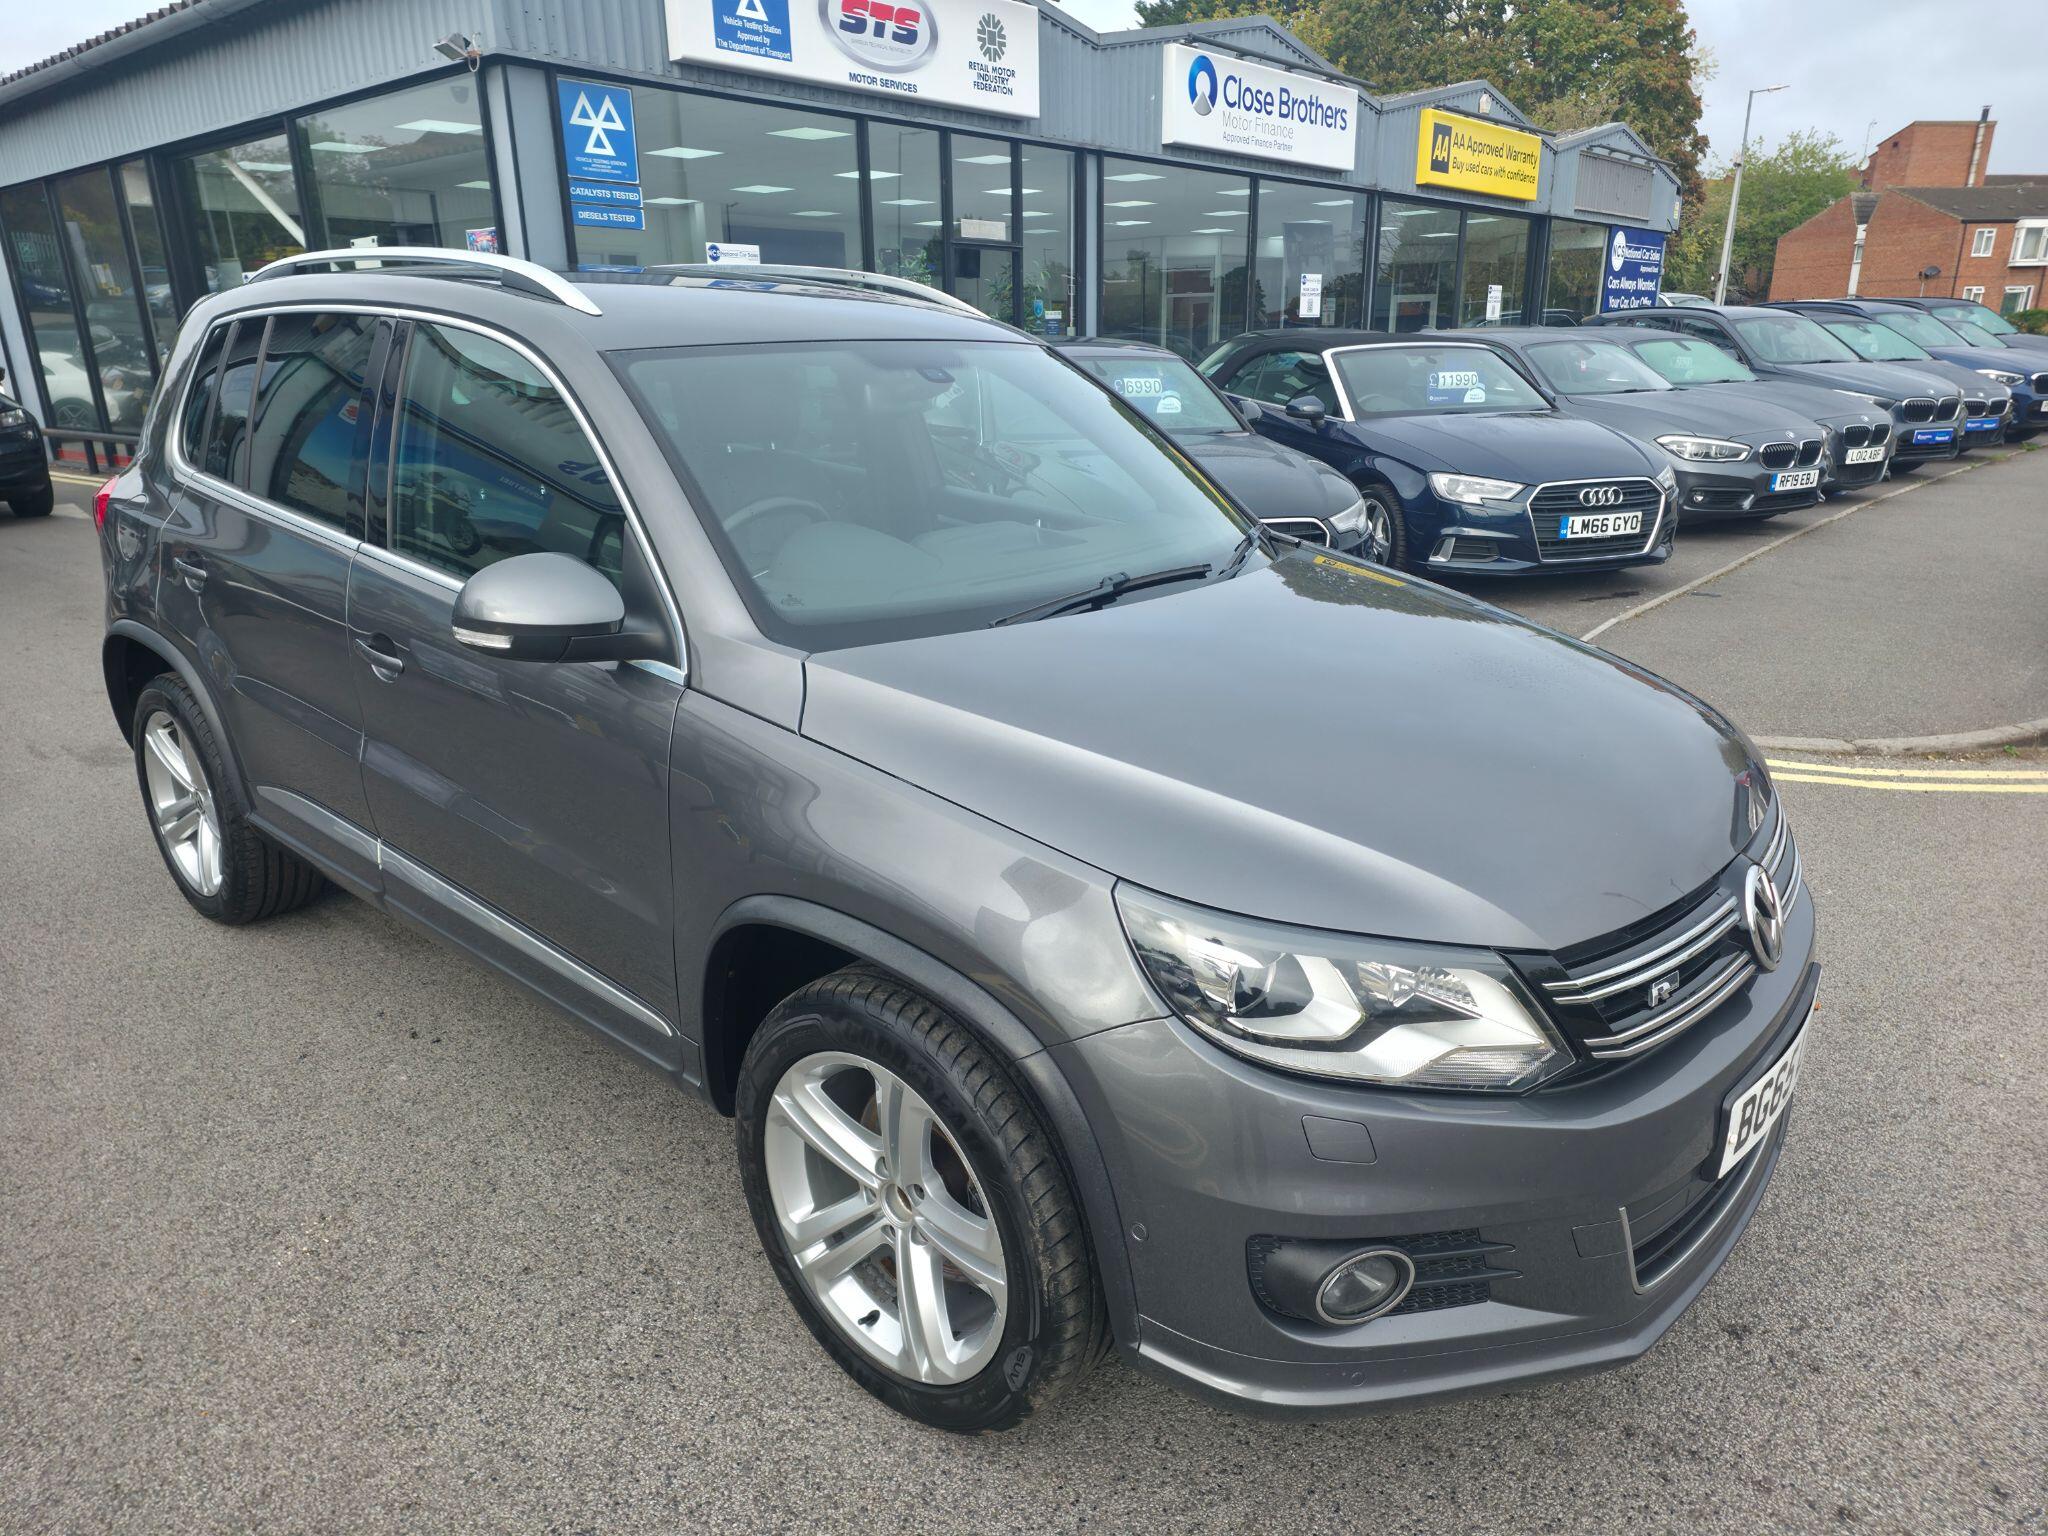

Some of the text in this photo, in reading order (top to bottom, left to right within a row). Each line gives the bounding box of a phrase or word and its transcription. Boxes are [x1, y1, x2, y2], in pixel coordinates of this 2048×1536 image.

[722, 14, 782, 35] Vehicle Testing Station
[839, 0, 921, 46] STS
[737, 30, 770, 46] Approved by
[717, 37, 728, 48] The
[728, 40, 759, 55] Department
[765, 47, 791, 60] Transport
[968, 61, 1015, 78] RETAIL MOTOR
[976, 72, 1010, 86] INDUSTRY
[849, 72, 918, 94] MOTOR SERVICES
[973, 81, 1013, 96] FEDERATION
[1223, 75, 1347, 131] Close Brothers
[1222, 111, 1294, 139] Motor Finance
[1222, 131, 1293, 152] Approved Finance Partner
[1432, 134, 1449, 162] AA
[1452, 132, 1538, 170] AA Approved Warranty
[1452, 156, 1536, 184] Buy used cars with confidence
[570, 187, 639, 201] CATALYSTS TESTED
[578, 211, 636, 223] DIESELS TESTED
[1625, 247, 1660, 261] National Car Sales
[1608, 276, 1620, 289] Cars
[1620, 277, 1637, 293] Always
[1608, 296, 1620, 308] Your
[1630, 296, 1640, 308] Our
[1779, 473, 1817, 488] RF19 EBJ
[1570, 515, 1639, 535] LM66 GYO
[1010, 1351, 1026, 1384] SUV
